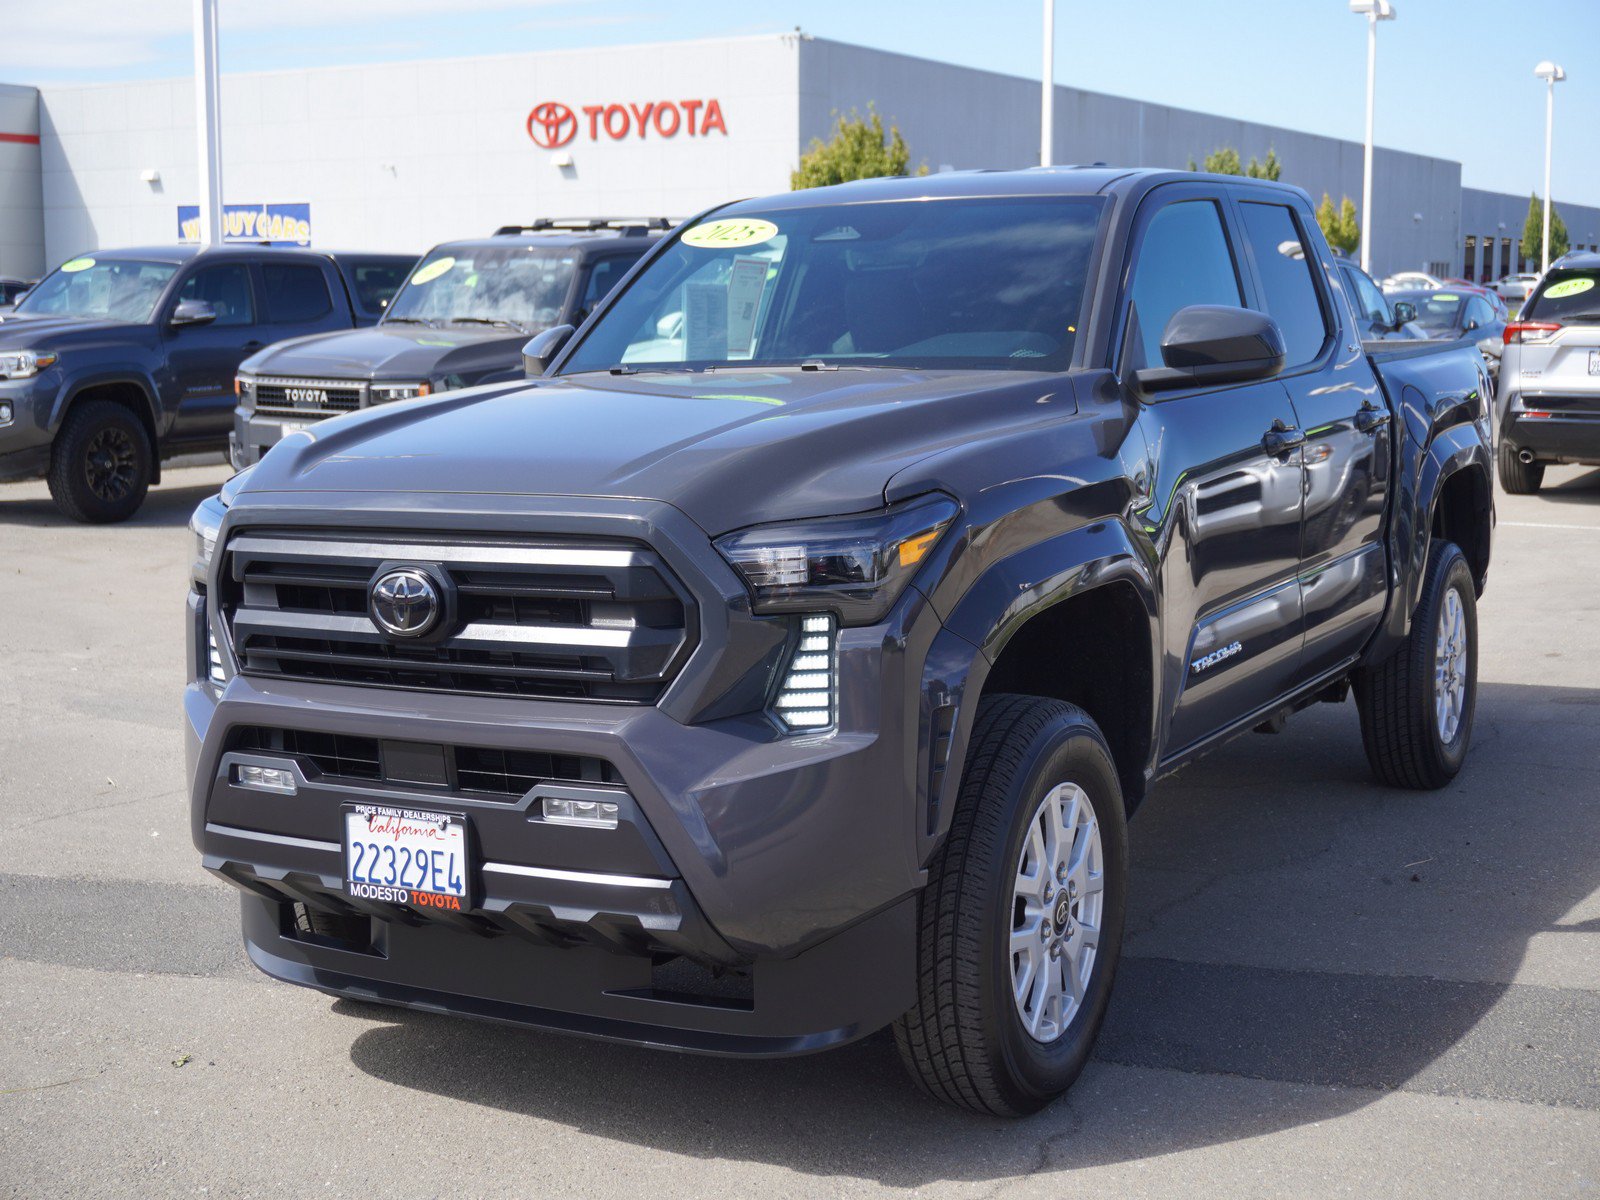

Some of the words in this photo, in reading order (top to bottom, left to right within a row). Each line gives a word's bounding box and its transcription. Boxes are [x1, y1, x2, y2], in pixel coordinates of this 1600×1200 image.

[582, 99, 728, 141] TOYOTA
[256, 212, 310, 246] CARS
[284, 388, 329, 403] TOYOTA
[355, 805, 377, 815] PRICE
[378, 807, 402, 818] FAMILY
[403, 810, 451, 823] DEALERSHIPS
[367, 813, 446, 842] California
[351, 841, 463, 894] 22329E4
[350, 882, 408, 903] MODESTO
[410, 890, 461, 910] TOYOTA
